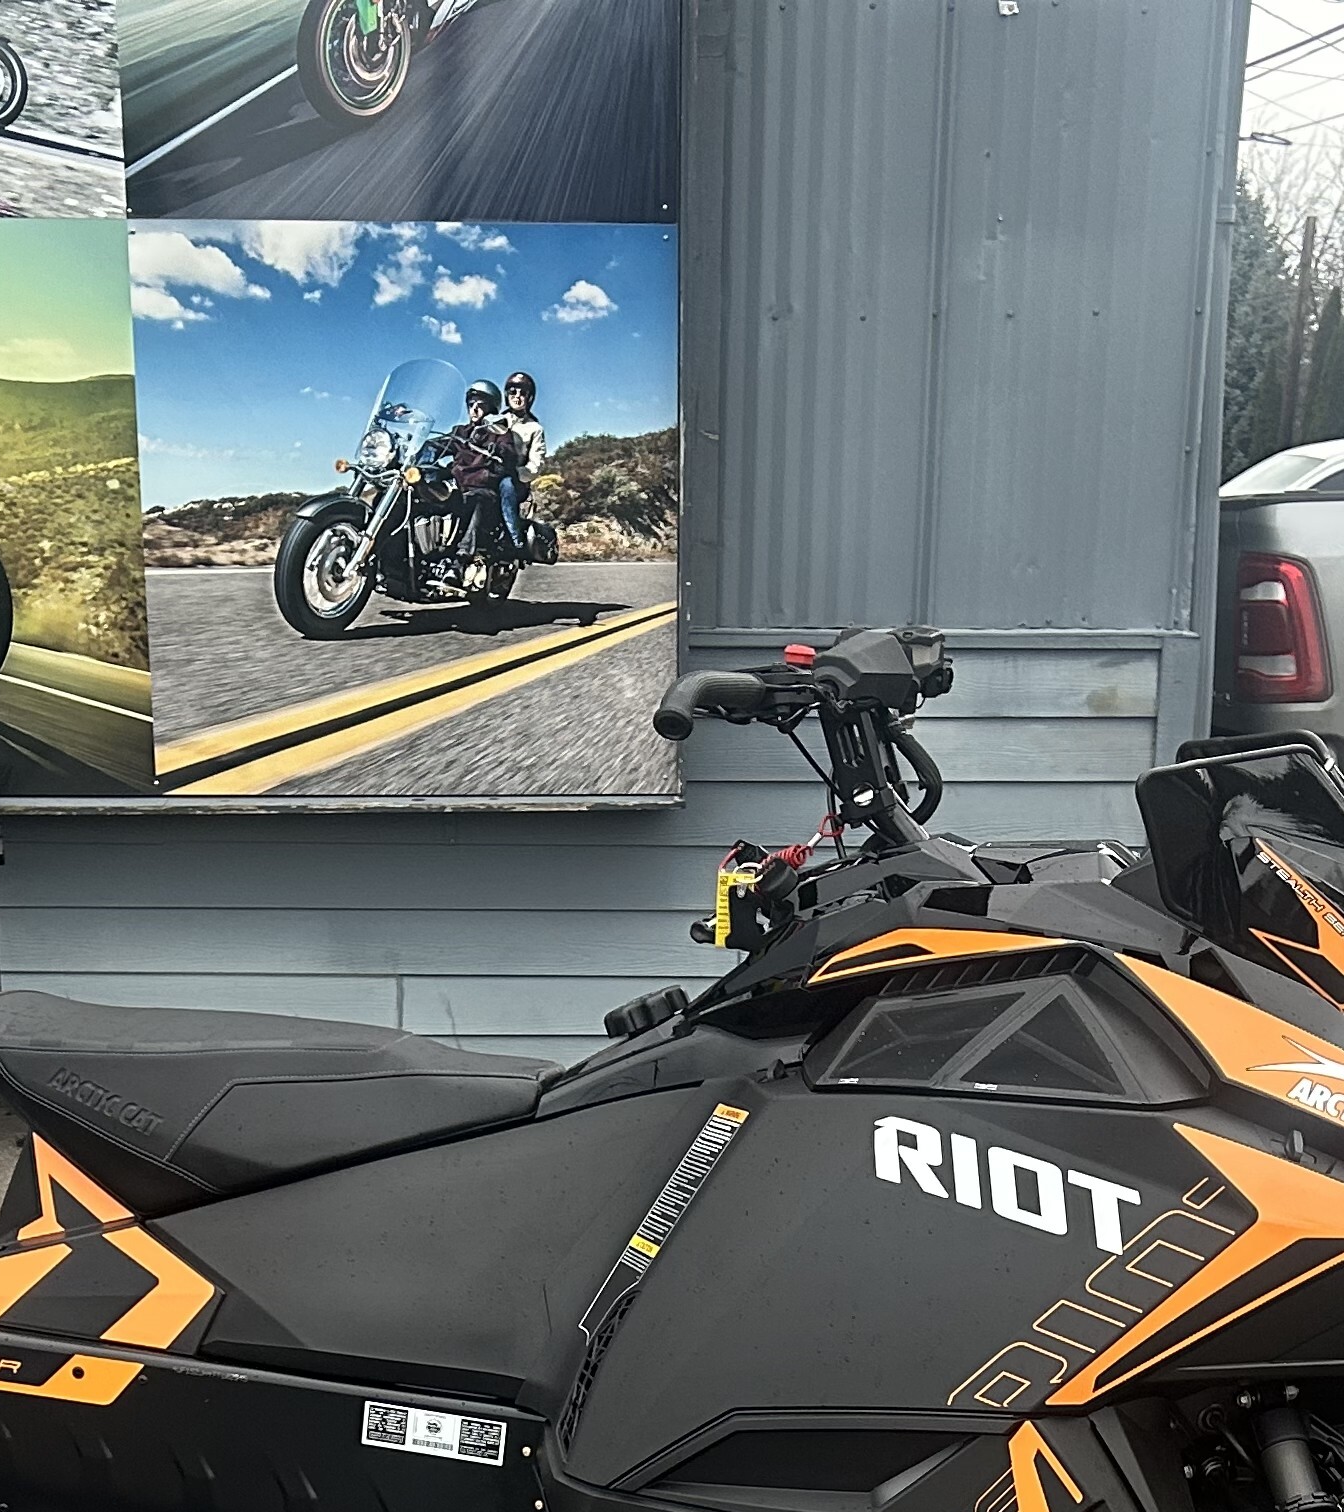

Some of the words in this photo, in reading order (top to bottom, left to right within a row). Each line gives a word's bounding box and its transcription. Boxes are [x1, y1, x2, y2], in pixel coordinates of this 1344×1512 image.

[1256, 851, 1326, 913] STEALTH
[46, 1066, 123, 1118] ARCTIC
[119, 1102, 165, 1137] CAT
[873, 1115, 1142, 1256] RIOT
